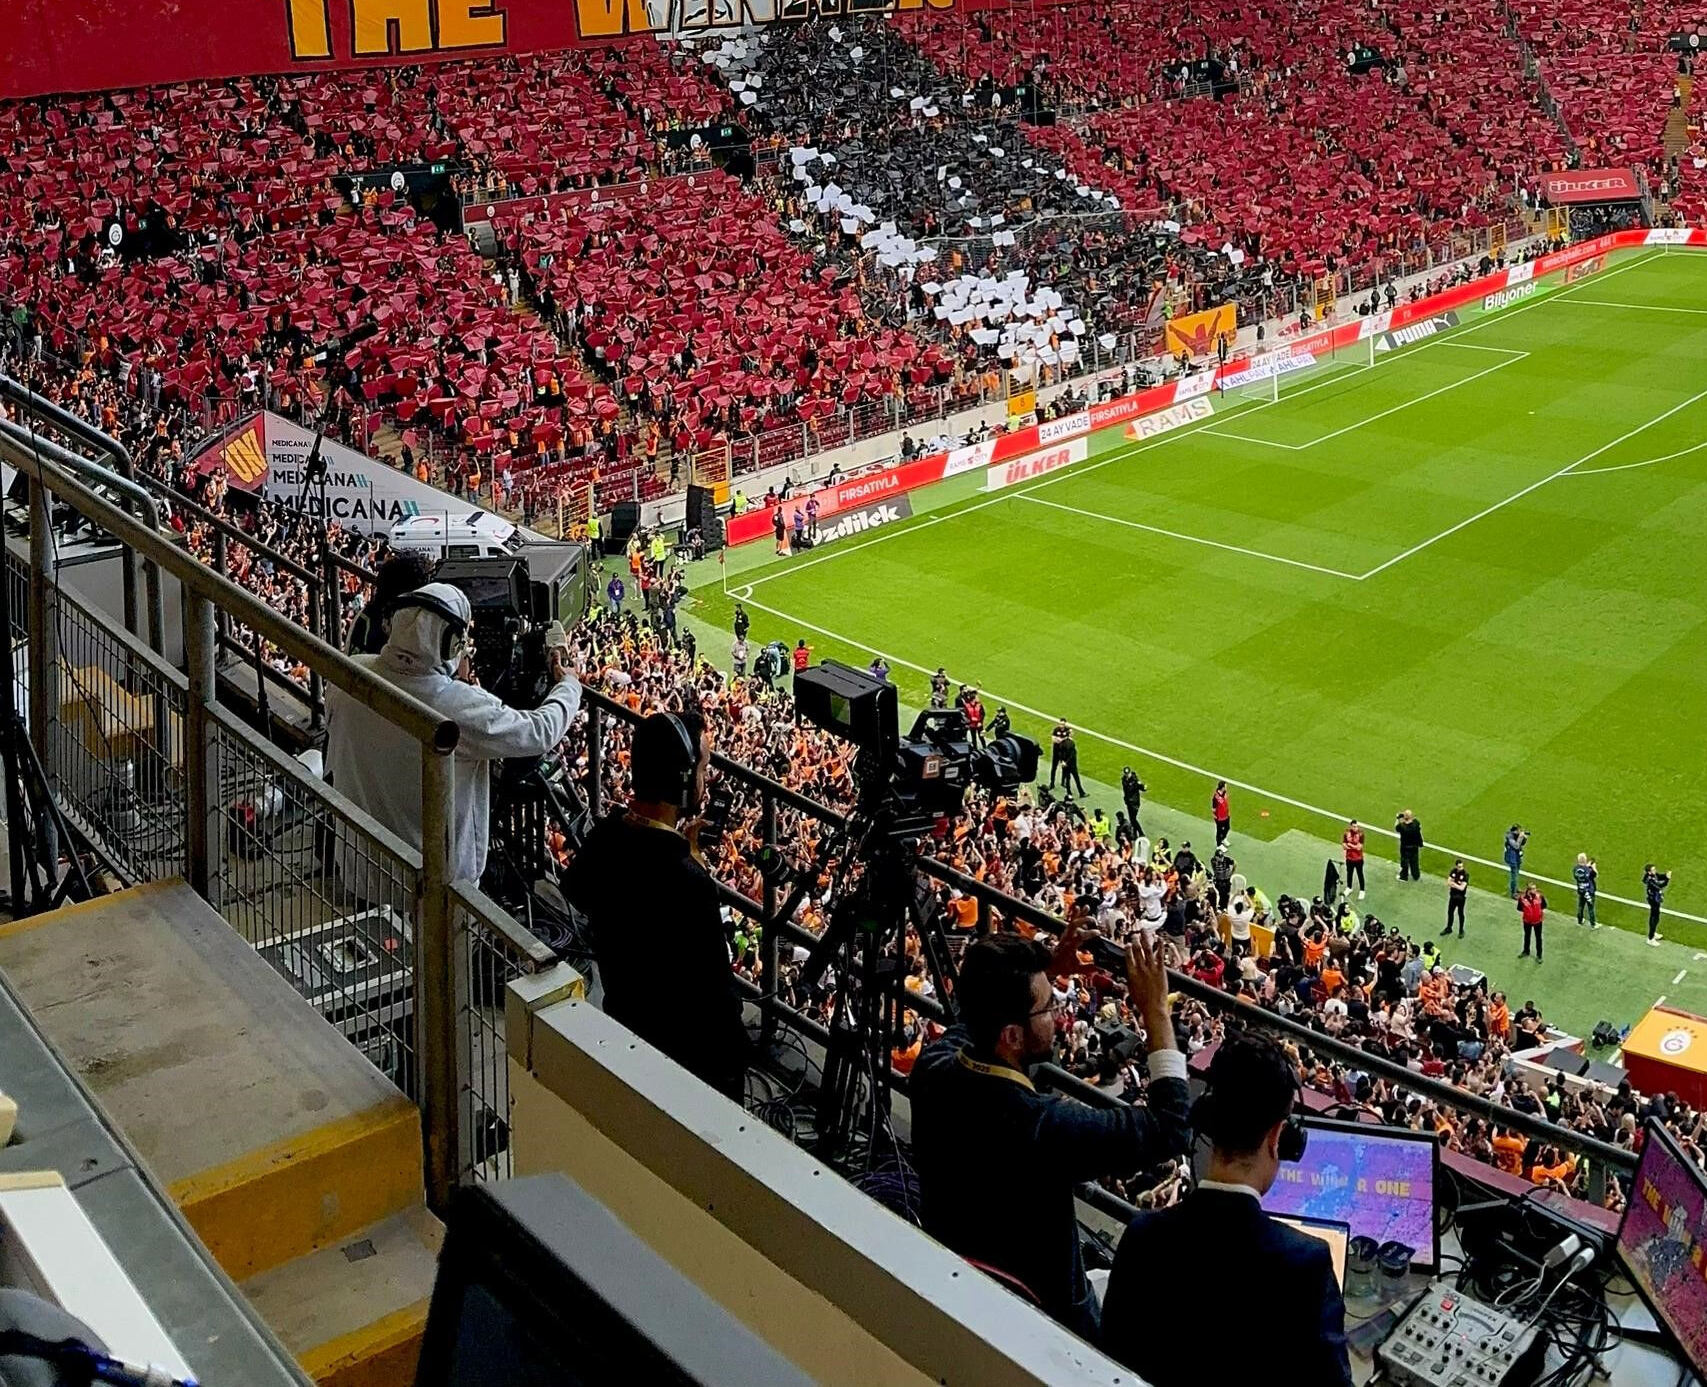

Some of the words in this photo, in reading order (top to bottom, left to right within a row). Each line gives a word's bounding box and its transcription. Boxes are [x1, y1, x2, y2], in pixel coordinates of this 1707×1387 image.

[1551, 177, 1629, 194] ÜLKER
[1485, 281, 1538, 311] Bilyoner
[1395, 321, 1436, 347] PUMA
[1041, 428, 1052, 440] 24
[1053, 424, 1065, 437] AY
[1065, 416, 1088, 433] VADE
[1091, 399, 1138, 423] FIRSATIYLA
[1139, 397, 1208, 436] RAMS
[272, 439, 308, 448] MEDICANA
[273, 454, 326, 464] MEDICAA
[1005, 448, 1070, 484] ÜLKER
[273, 471, 357, 488] MEDCANA
[839, 475, 899, 501] FIRSATIYLA
[1375, 1179, 1411, 1197] ONE
